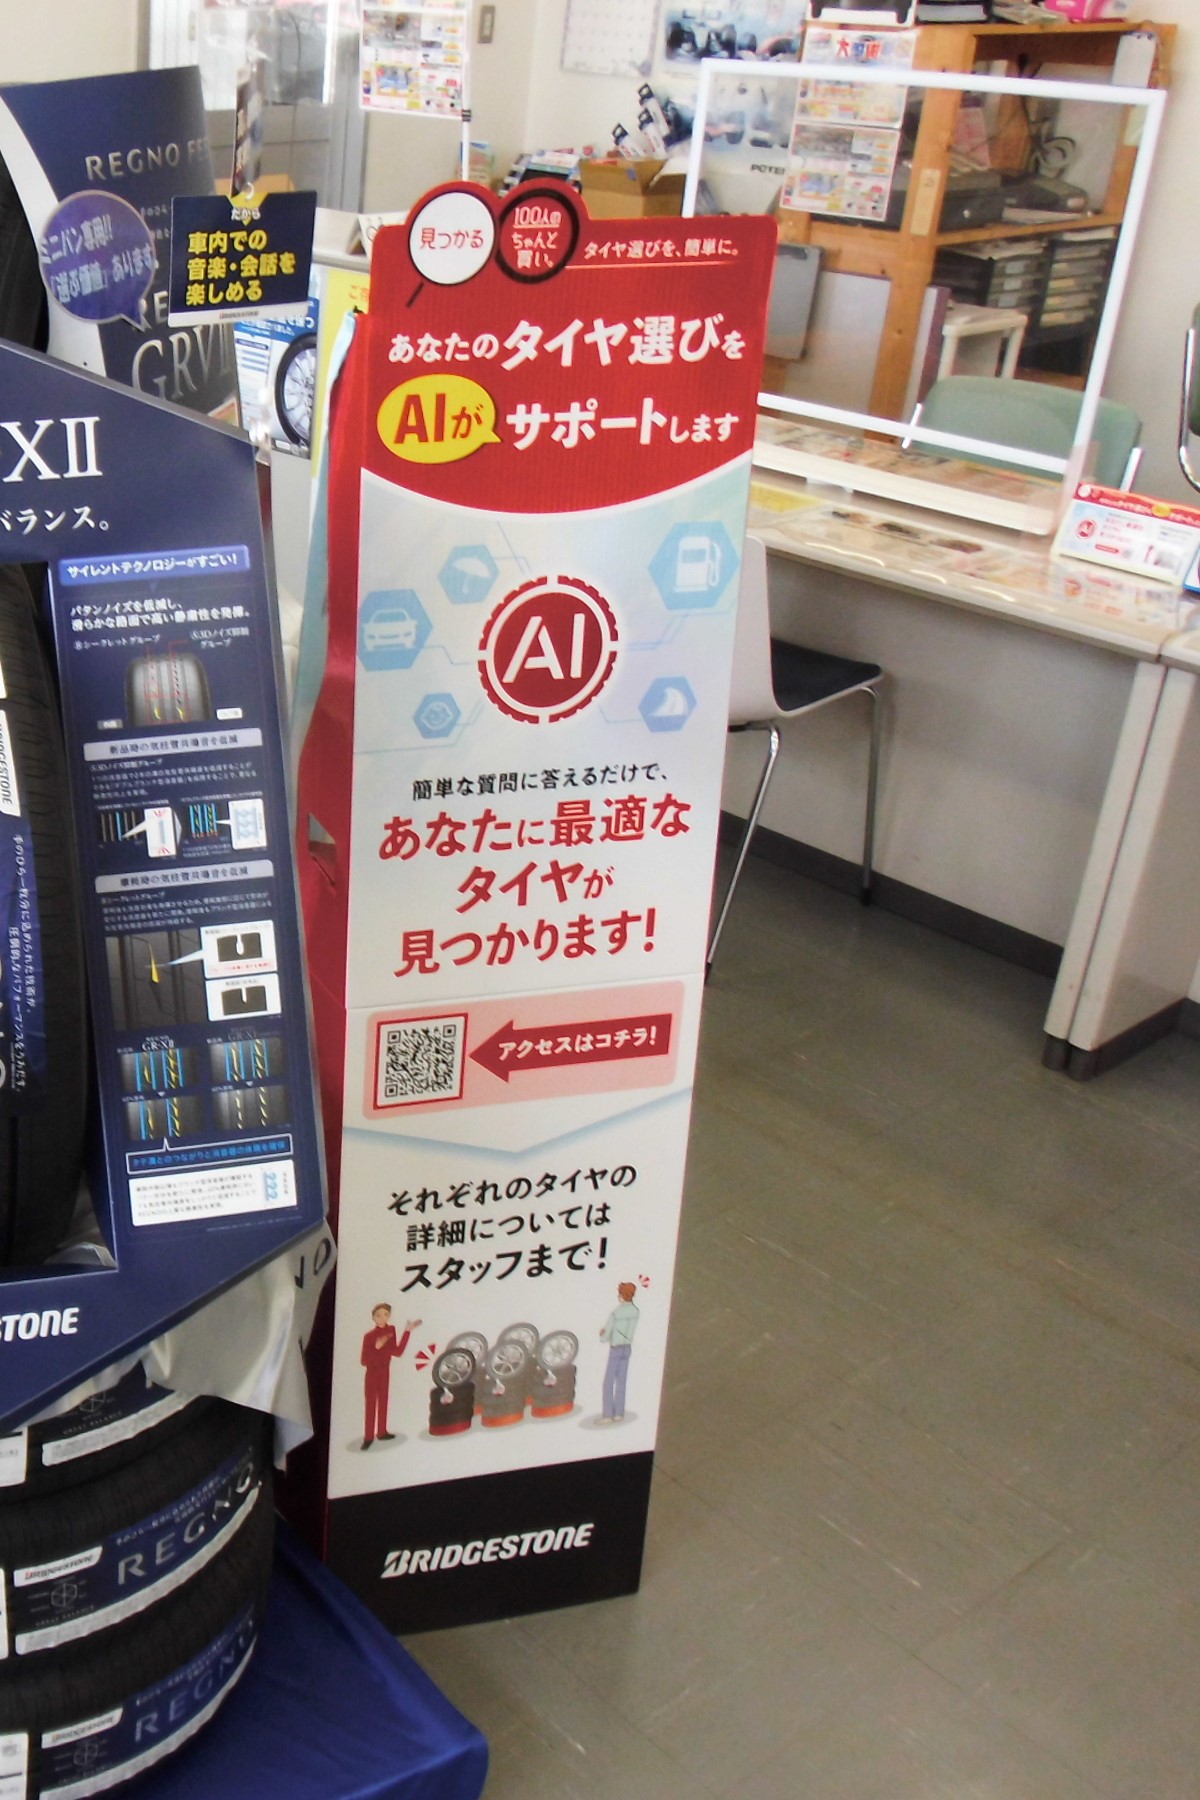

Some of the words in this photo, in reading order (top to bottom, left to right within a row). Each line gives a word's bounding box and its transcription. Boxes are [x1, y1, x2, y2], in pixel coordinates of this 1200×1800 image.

[85, 142, 180, 181] REGNO
[231, 206, 261, 221] だから
[188, 230, 268, 255] 車内での
[419, 227, 485, 250] 見つかる
[511, 231, 558, 251] ちゃんと
[583, 238, 740, 261] タイヤ選びを、簡単に。
[187, 252, 297, 281] 音楽・会話を
[186, 280, 263, 306] 楽しめる
[387, 312, 746, 372] あなたのタイヤ選びを
[393, 393, 485, 445] AIが
[506, 397, 740, 451] サポートします
[501, 612, 586, 684] AI
[411, 762, 669, 802] 簡単な質問に答えるだけで、
[378, 792, 692, 861] あなたに最適な
[455, 857, 617, 914] タイヤが
[393, 907, 657, 978] 見つかります！
[498, 1025, 658, 1061] アクセスはコチラ！
[387, 1164, 638, 1216] それぞれのタイヤの
[406, 1202, 612, 1252] 詳細については
[400, 1237, 608, 1293] スタッフまで！
[380, 1522, 595, 1580] BRIDGESTONE
